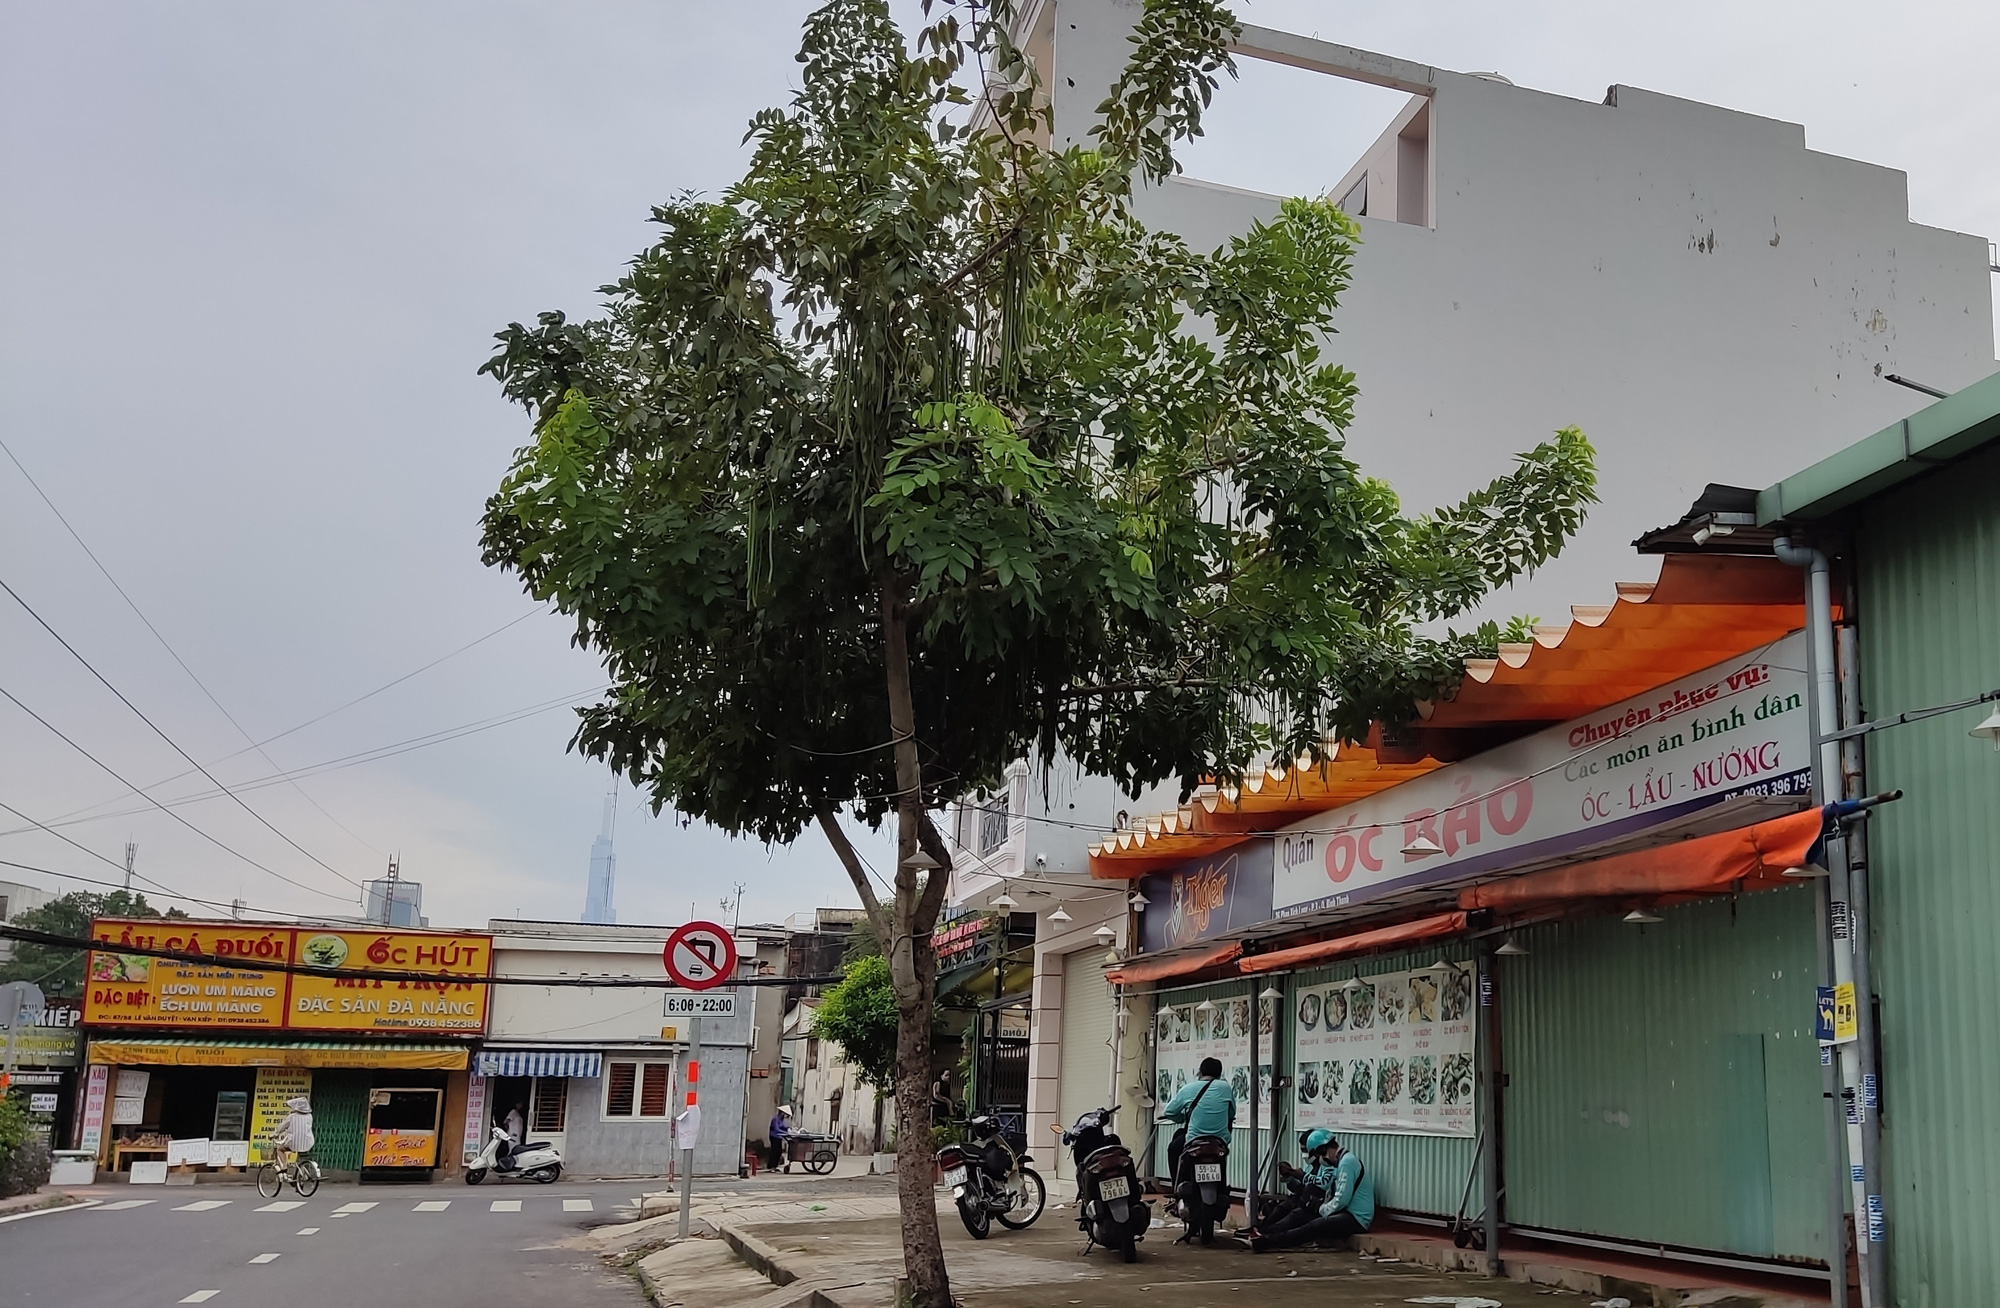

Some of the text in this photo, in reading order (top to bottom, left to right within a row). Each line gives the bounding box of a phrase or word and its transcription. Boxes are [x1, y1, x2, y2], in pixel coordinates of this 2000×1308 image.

[1568, 707, 1652, 747] Chuyên
[1727, 664, 1769, 690] vụ:
[1606, 741, 1650, 770] món
[1657, 733, 1684, 754] ăn
[1691, 705, 1745, 743] bình
[1754, 693, 1802, 721] dân
[1581, 787, 1611, 822] ỐC
[1628, 766, 1673, 810] LẨU
[1693, 741, 1779, 791] NƯỚNG
[1771, 778, 1790, 796] 396
[1793, 771, 1812, 791] 793
[1282, 775, 1534, 883] Quán ỐC BẢO
[1184, 864, 1228, 932] Tiger
[215, 933, 285, 959] ĐUỐI
[415, 940, 479, 967] HÚT
[94, 988, 122, 1008] ĐẶC
[205, 985, 226, 997] UM
[191, 1000, 212, 1012] UM
[297, 994, 475, 1016] ĐẶC SẢN ĐÀ NẴNG
[408, 1018, 437, 1027] 0938
[438, 1019, 481, 1028] 452386
